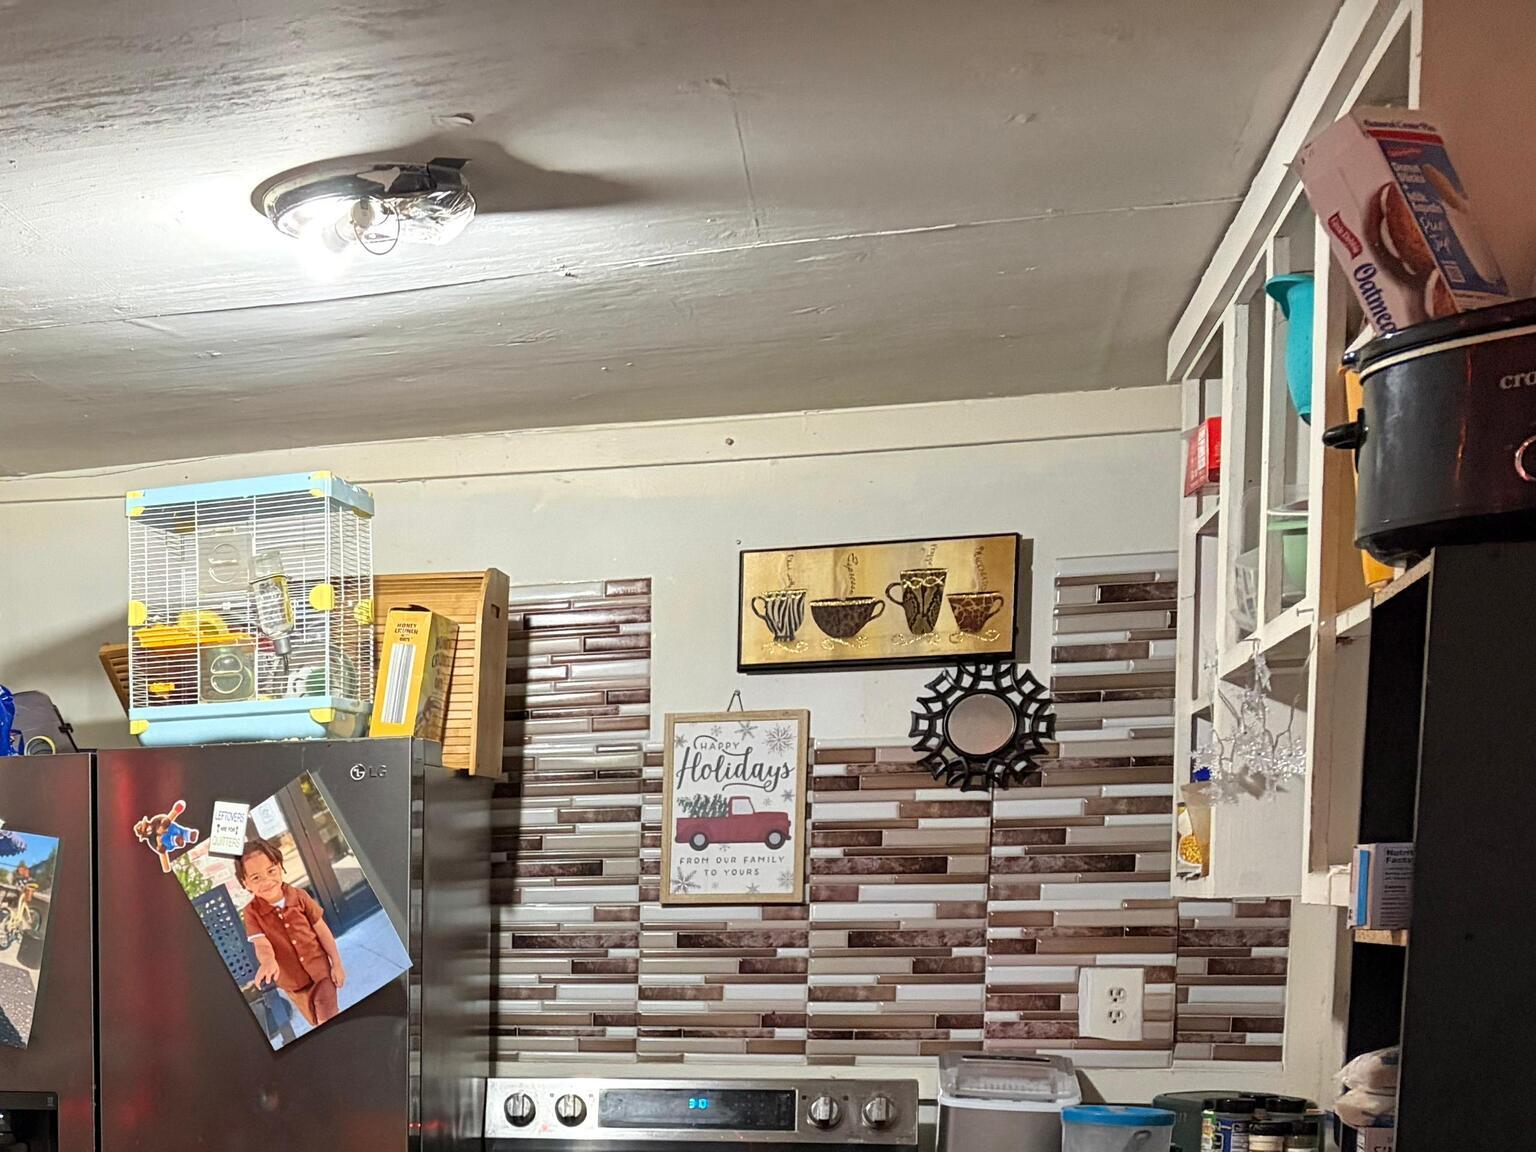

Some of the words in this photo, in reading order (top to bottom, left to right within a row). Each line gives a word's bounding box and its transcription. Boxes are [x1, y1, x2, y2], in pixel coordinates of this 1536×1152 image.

[1353, 262, 1398, 335] Oatmea
[1500, 371, 1536, 390] cro
[369, 765, 387, 778] LG
[676, 746, 795, 792] Holidays
[716, 856, 737, 864] OUR
[743, 856, 785, 864] FAMILY
[724, 868, 760, 876] YOURS
